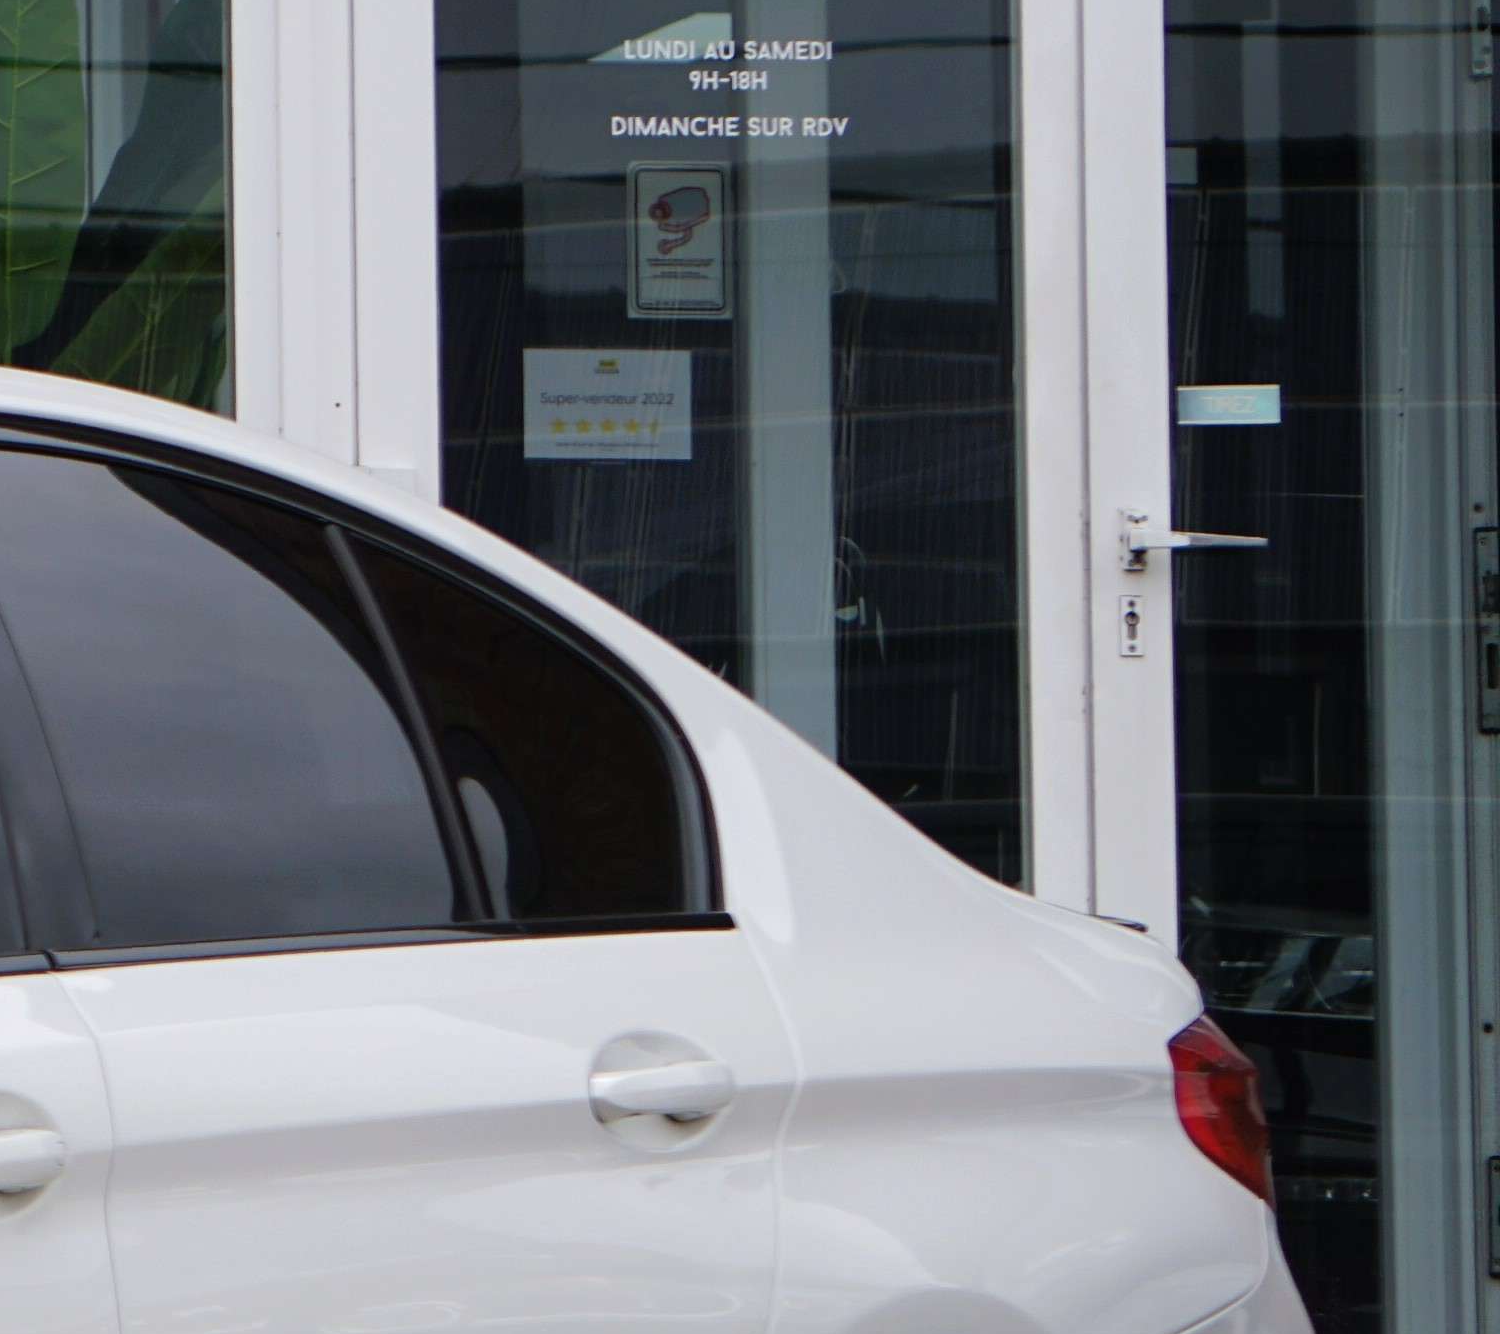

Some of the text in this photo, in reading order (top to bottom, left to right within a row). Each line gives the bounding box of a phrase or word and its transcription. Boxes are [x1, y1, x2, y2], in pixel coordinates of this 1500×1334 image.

[623, 40, 833, 60] LUNDI AU SAMEDI
[689, 70, 768, 90] 9H-18H
[611, 116, 849, 137] DIMANCHE SUR RDV
